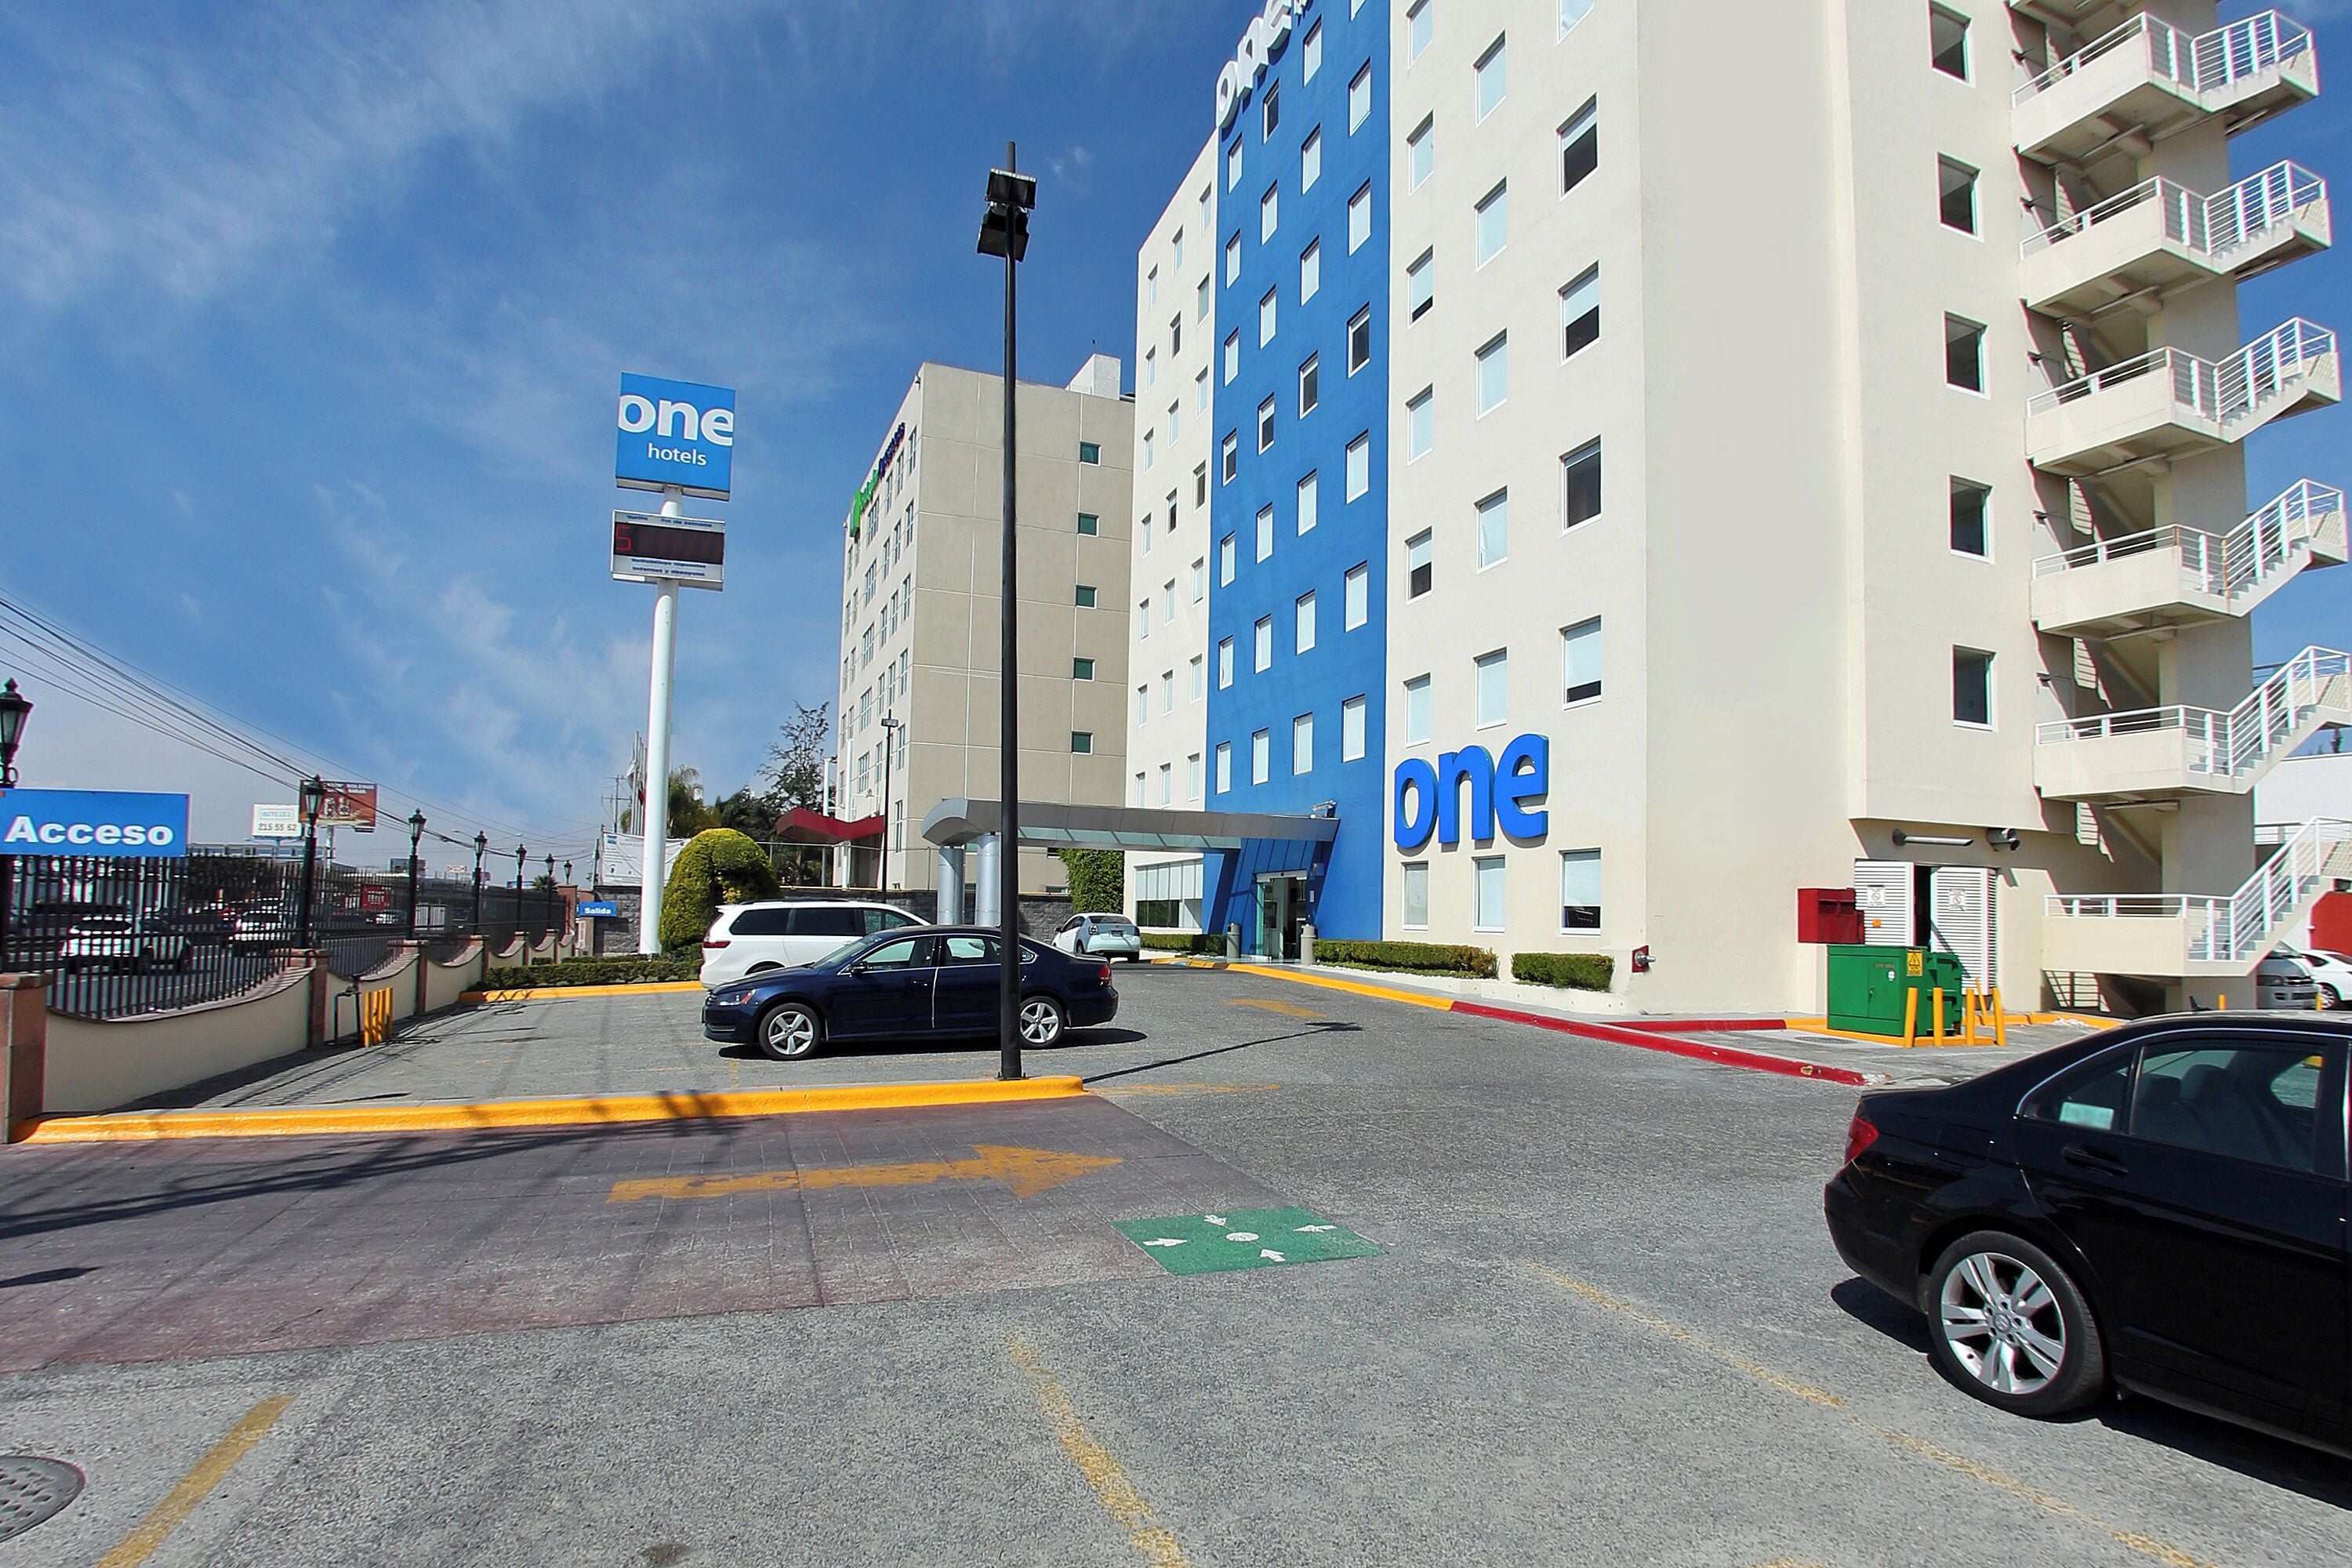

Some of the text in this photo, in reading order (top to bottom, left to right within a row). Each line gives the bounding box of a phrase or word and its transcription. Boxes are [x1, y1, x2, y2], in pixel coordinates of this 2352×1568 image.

[618, 394, 734, 446] one
[648, 443, 707, 466] hotels
[1394, 733, 1549, 849] one
[4, 815, 174, 846] Acceso
